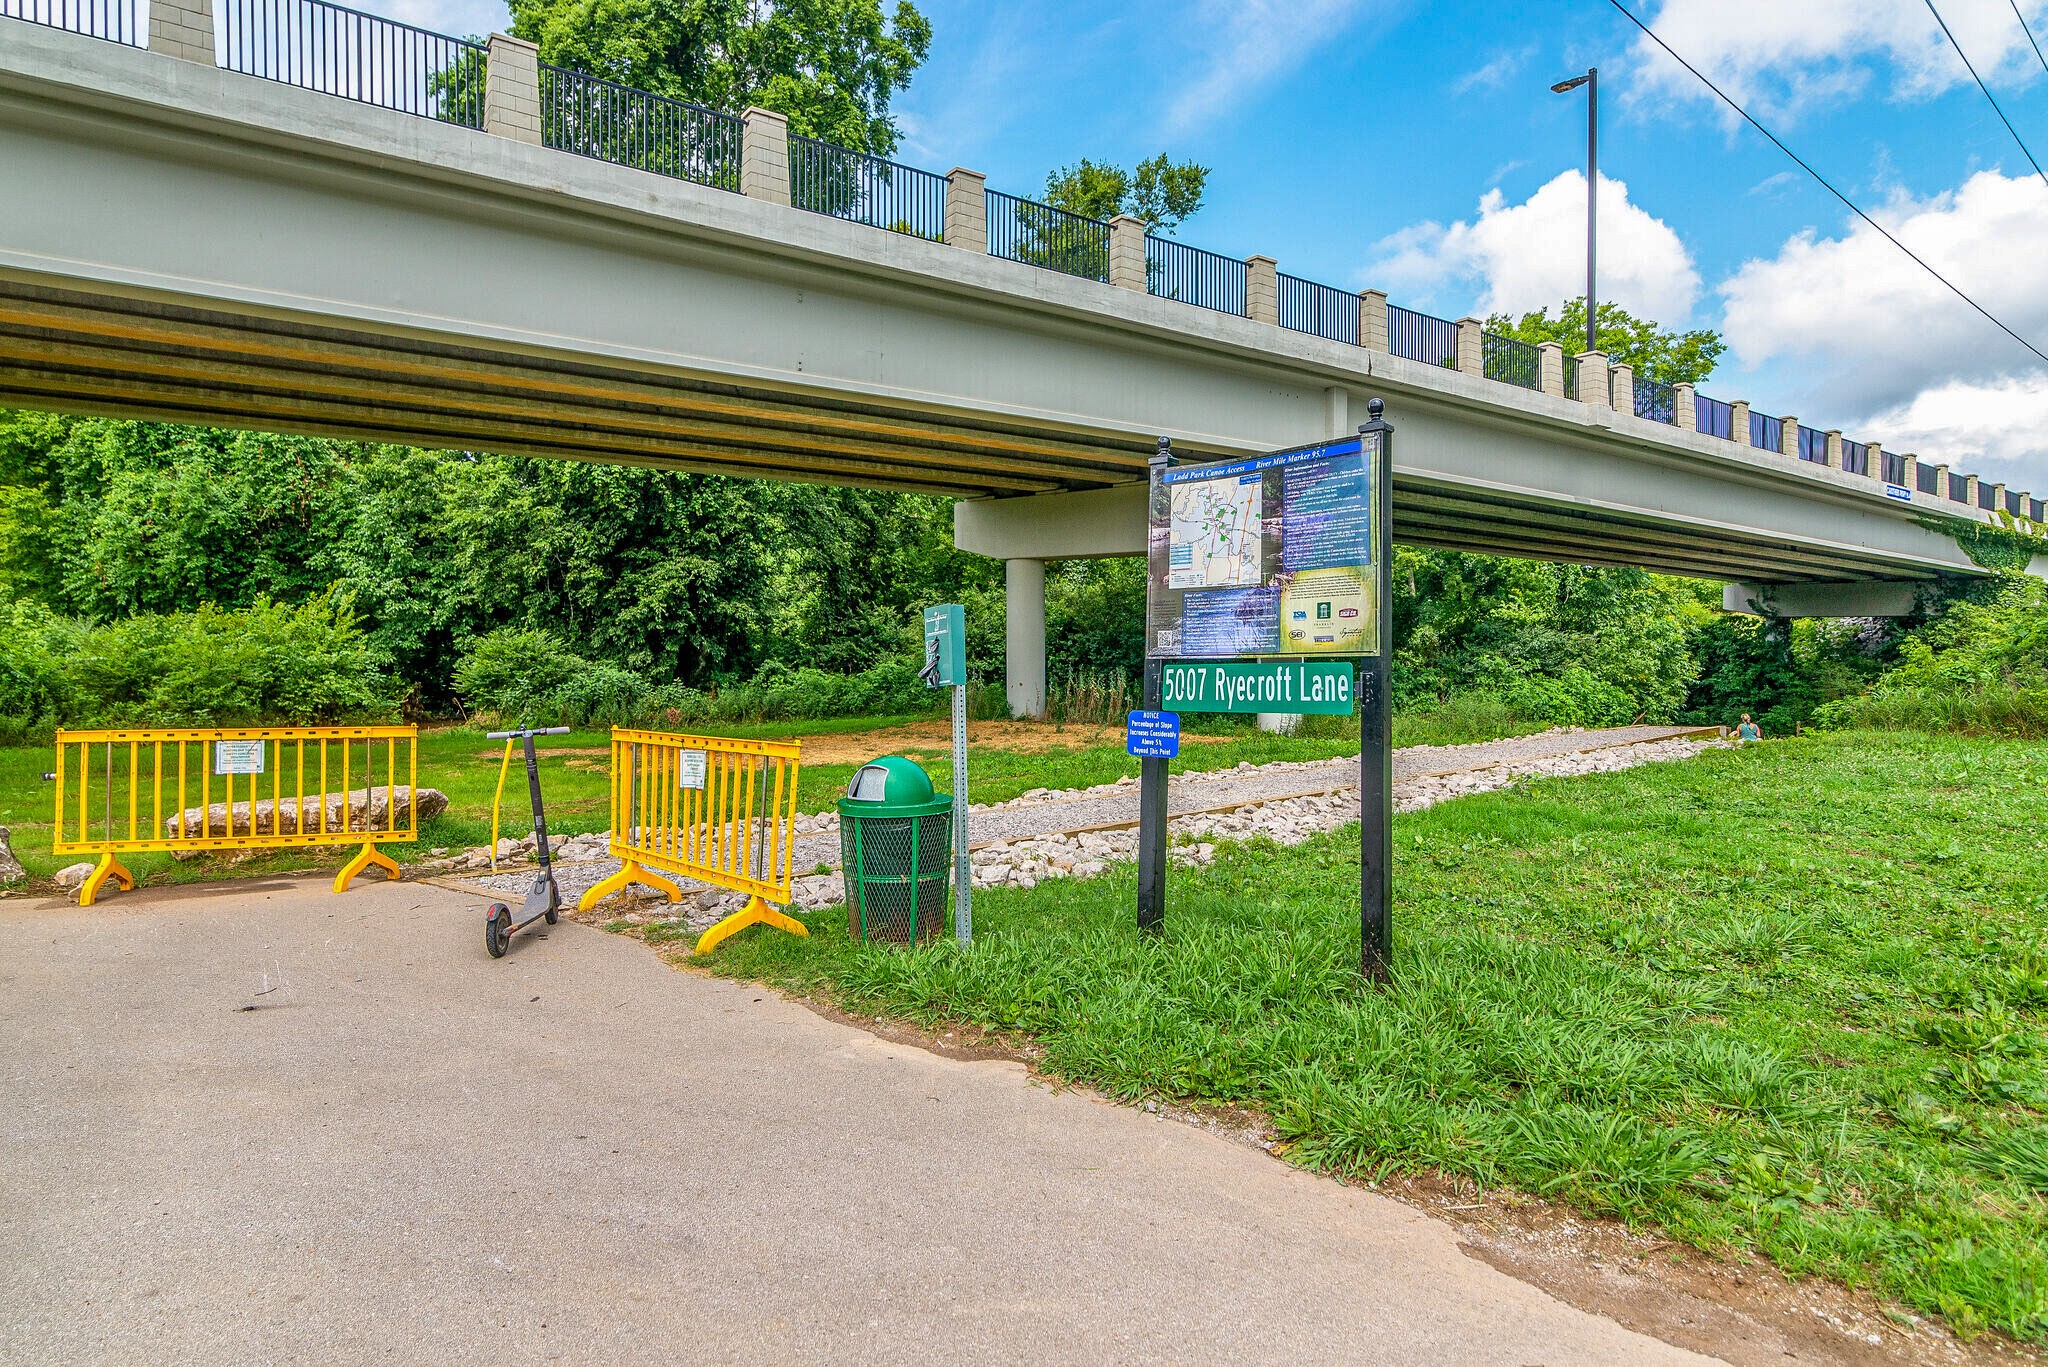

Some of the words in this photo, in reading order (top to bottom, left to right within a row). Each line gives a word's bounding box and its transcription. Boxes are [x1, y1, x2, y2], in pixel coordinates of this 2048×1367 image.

[1256, 460, 1272, 469] River
[1273, 457, 1286, 466] Mile
[1287, 453, 1310, 464] Marker
[1311, 449, 1326, 459] 95.7
[1173, 472, 1189, 481] Ladd
[1190, 469, 1205, 479] Park
[1206, 468, 1224, 477] Canoe
[1226, 465, 1245, 475] Access
[1164, 667, 1207, 701] 5007
[1215, 666, 1292, 710] Ryecroft
[1300, 666, 1349, 702] Lane
[1131, 720, 1154, 729] Percentage
[1160, 721, 1173, 729] Slope
[1150, 730, 1177, 739] Considerably
[1133, 746, 1149, 754] Beyond
[1150, 747, 1158, 755] This
